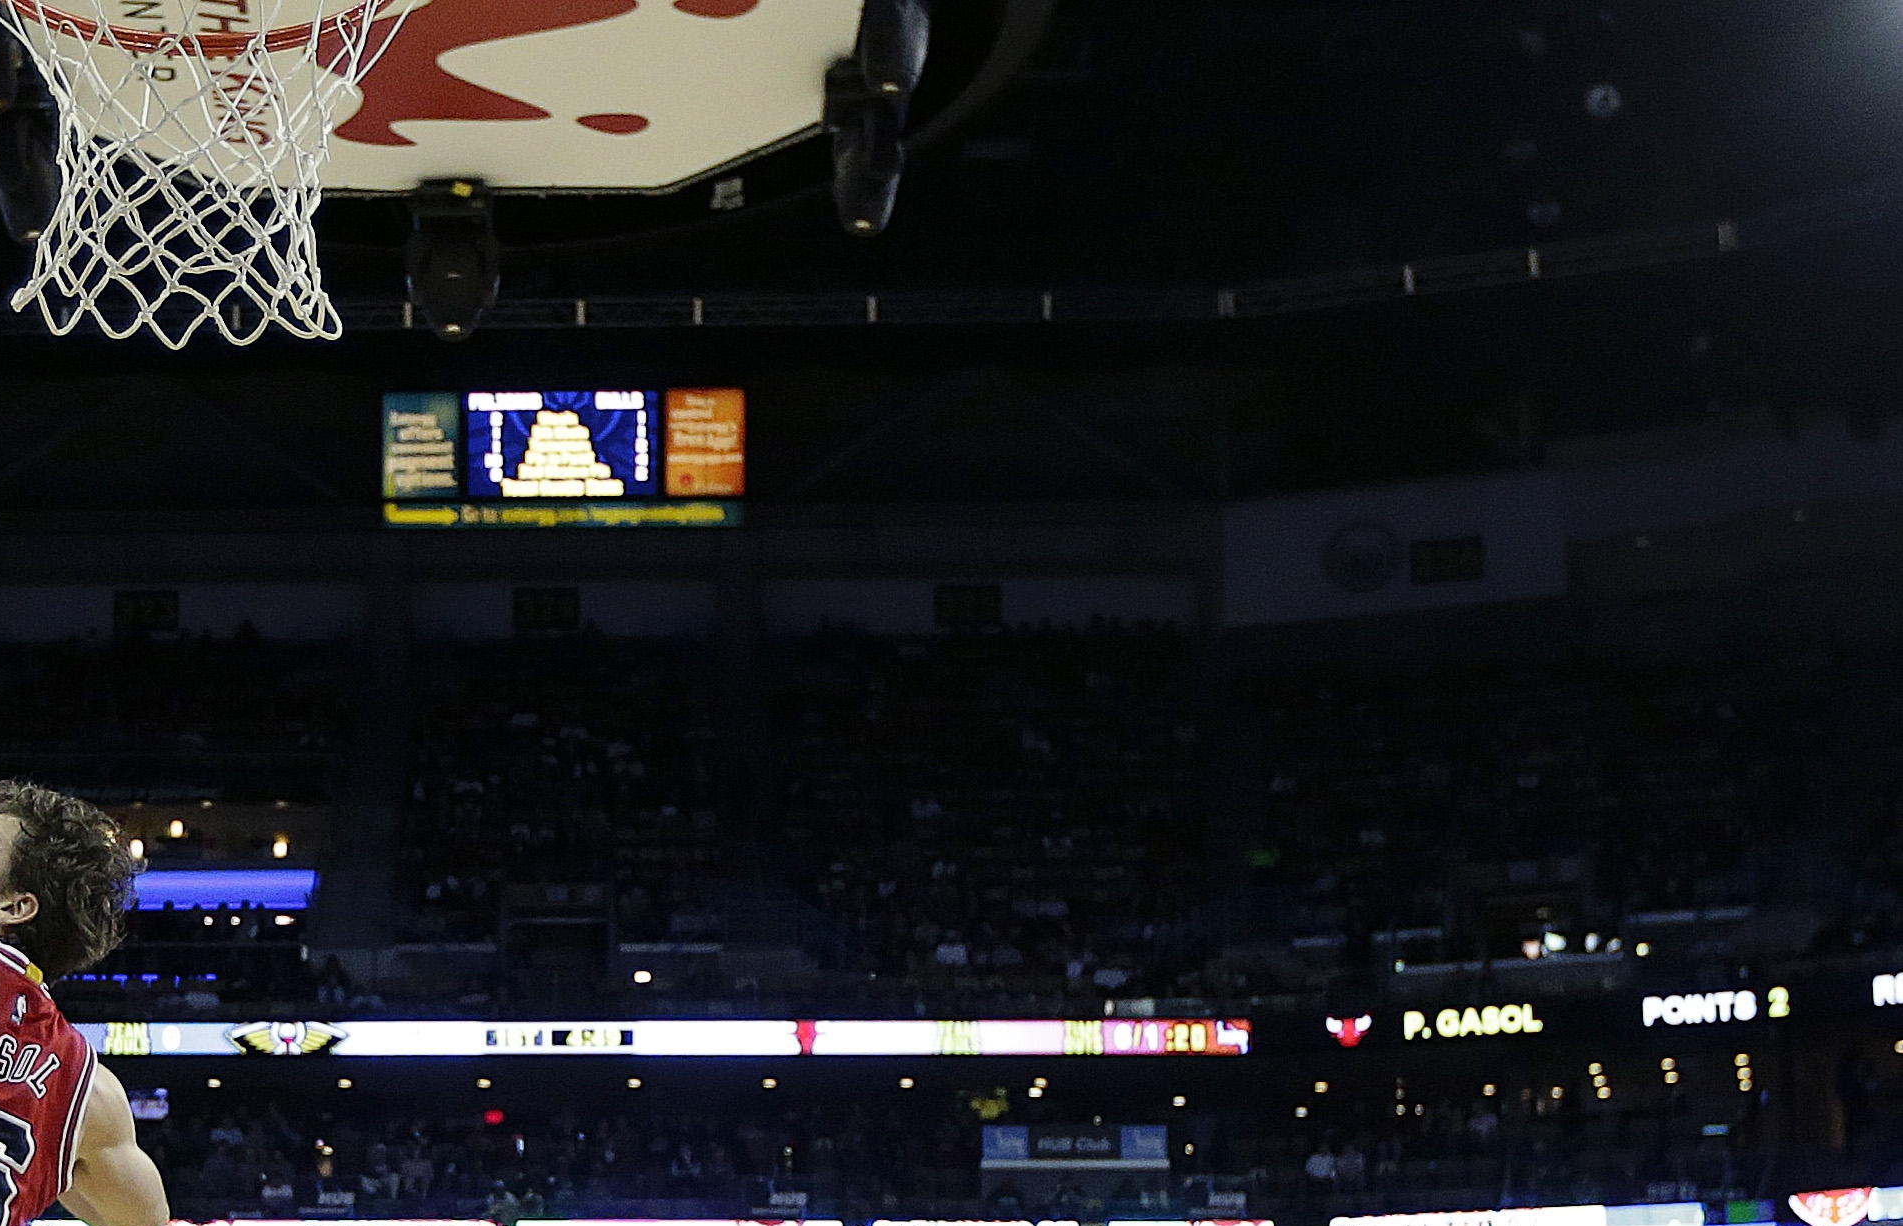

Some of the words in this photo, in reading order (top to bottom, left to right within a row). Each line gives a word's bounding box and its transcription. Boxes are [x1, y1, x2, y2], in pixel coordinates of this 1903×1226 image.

[1403, 1010, 1432, 1041] P.
[1435, 1003, 1544, 1038] GASOL
[1642, 989, 1757, 1027] POINTS
[1768, 986, 1791, 1018] 2
